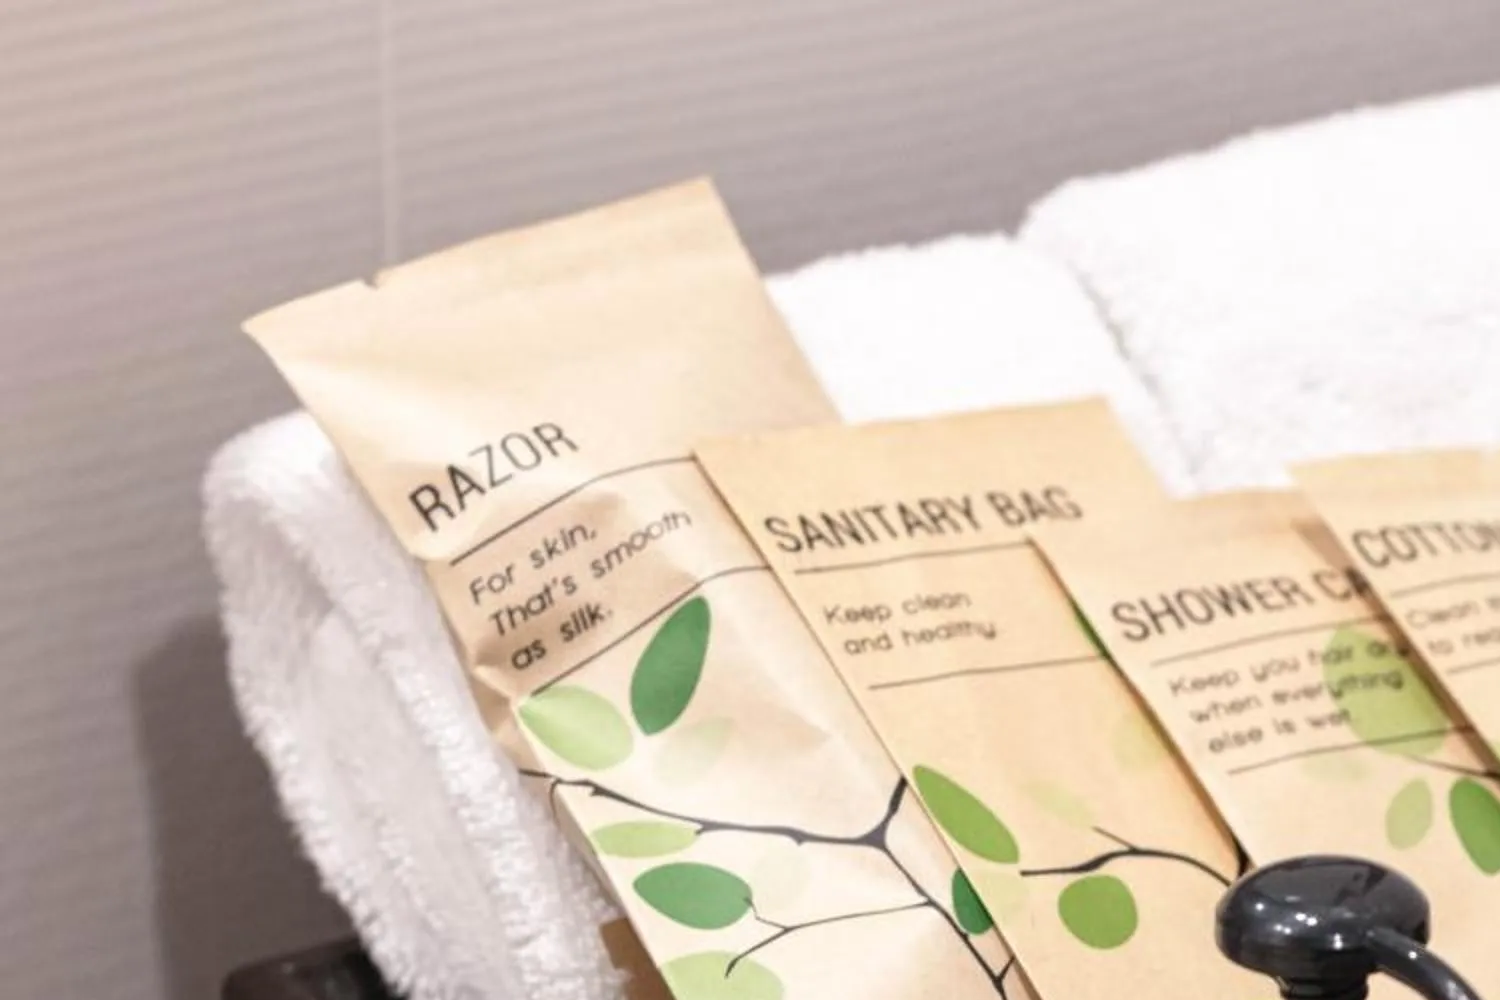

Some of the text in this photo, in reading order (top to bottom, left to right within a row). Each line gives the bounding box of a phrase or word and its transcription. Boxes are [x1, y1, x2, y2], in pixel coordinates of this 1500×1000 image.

[409, 422, 579, 532] RAZOR
[764, 485, 1084, 553] SANITARY BAG
[469, 564, 516, 605] For
[489, 510, 692, 636] That's smooth
[824, 591, 972, 626] Keep clean
[1111, 567, 1370, 643] SHOWER CA
[511, 604, 614, 671] as silk.
[843, 618, 998, 656] and healthy
[1168, 670, 1241, 697] Keep
[1190, 669, 1406, 723] when everything
[1208, 727, 1264, 754] else
[1271, 718, 1297, 736] is
